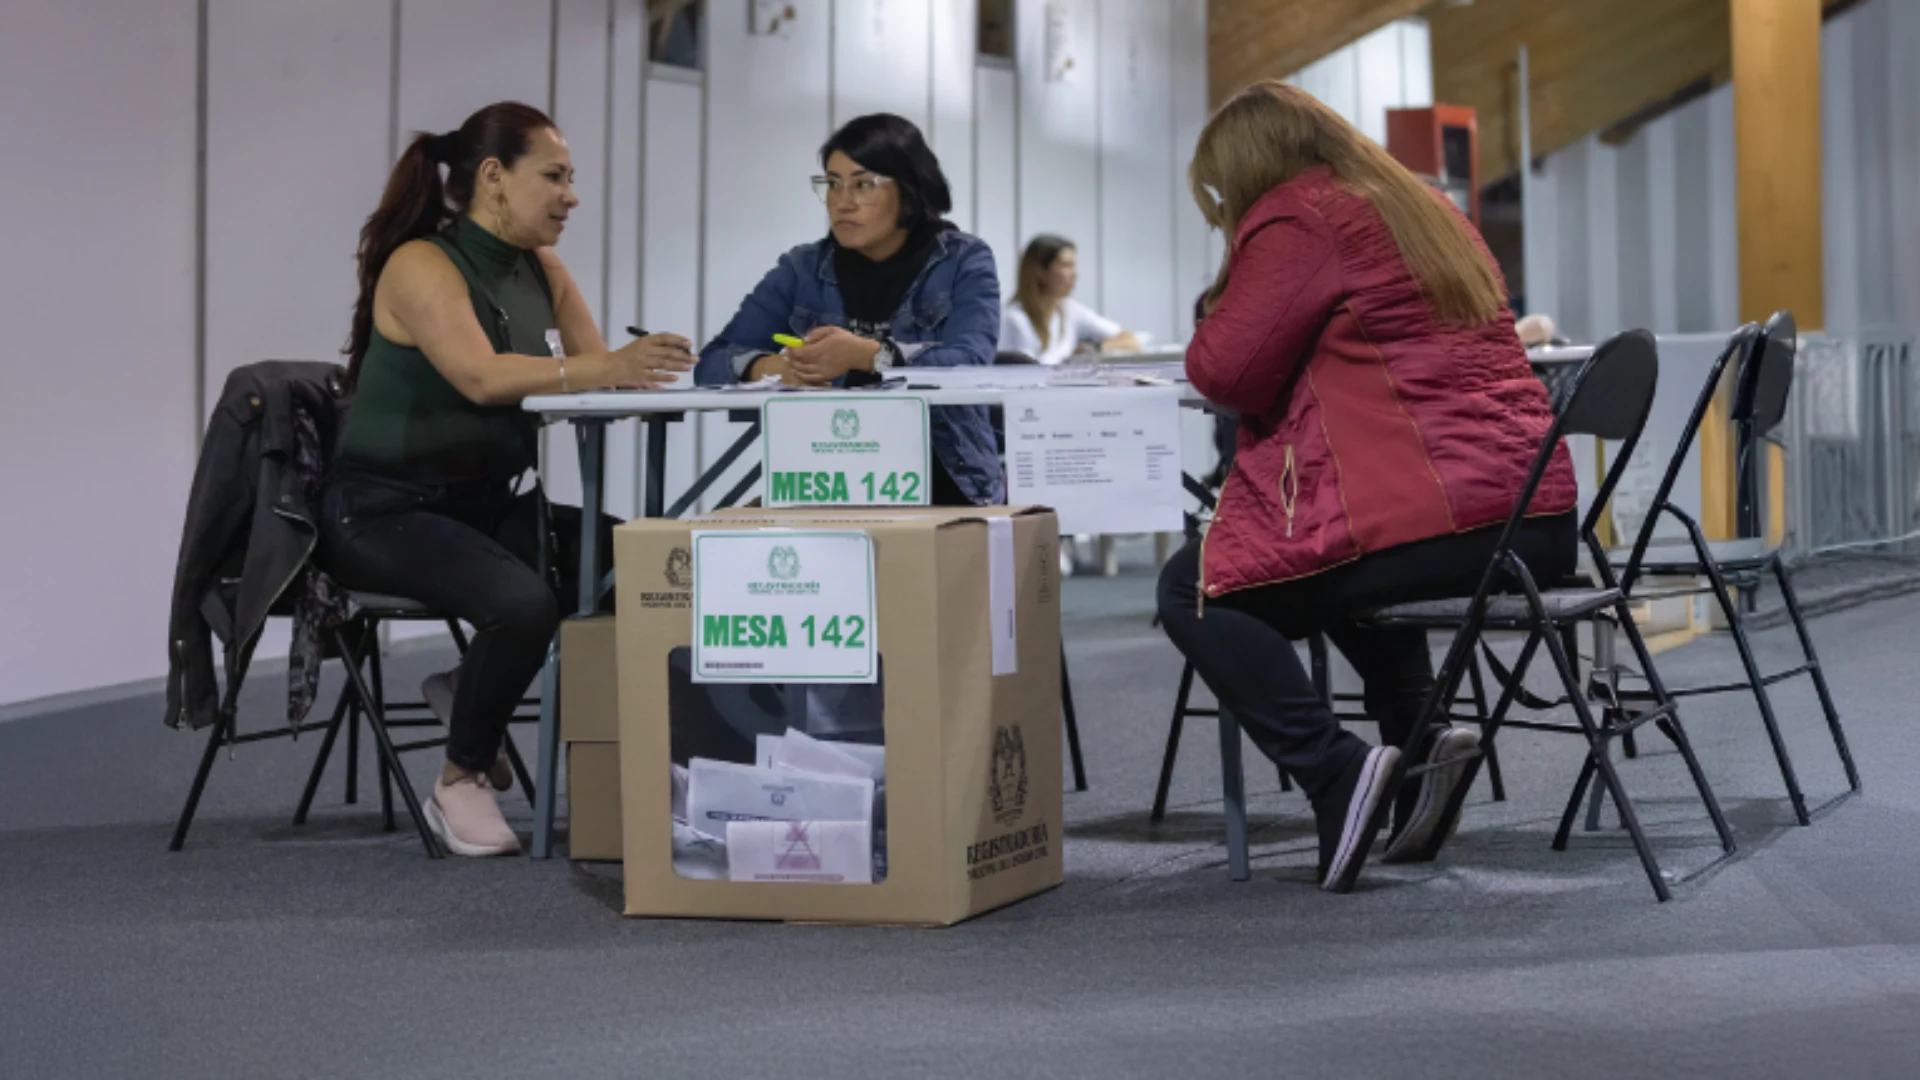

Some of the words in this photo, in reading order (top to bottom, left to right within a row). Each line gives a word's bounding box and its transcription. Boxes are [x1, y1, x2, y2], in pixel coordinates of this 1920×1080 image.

[772, 471, 849, 502] MESA
[861, 471, 920, 502] 142
[703, 615, 787, 647] MESA
[801, 615, 865, 648] 142
